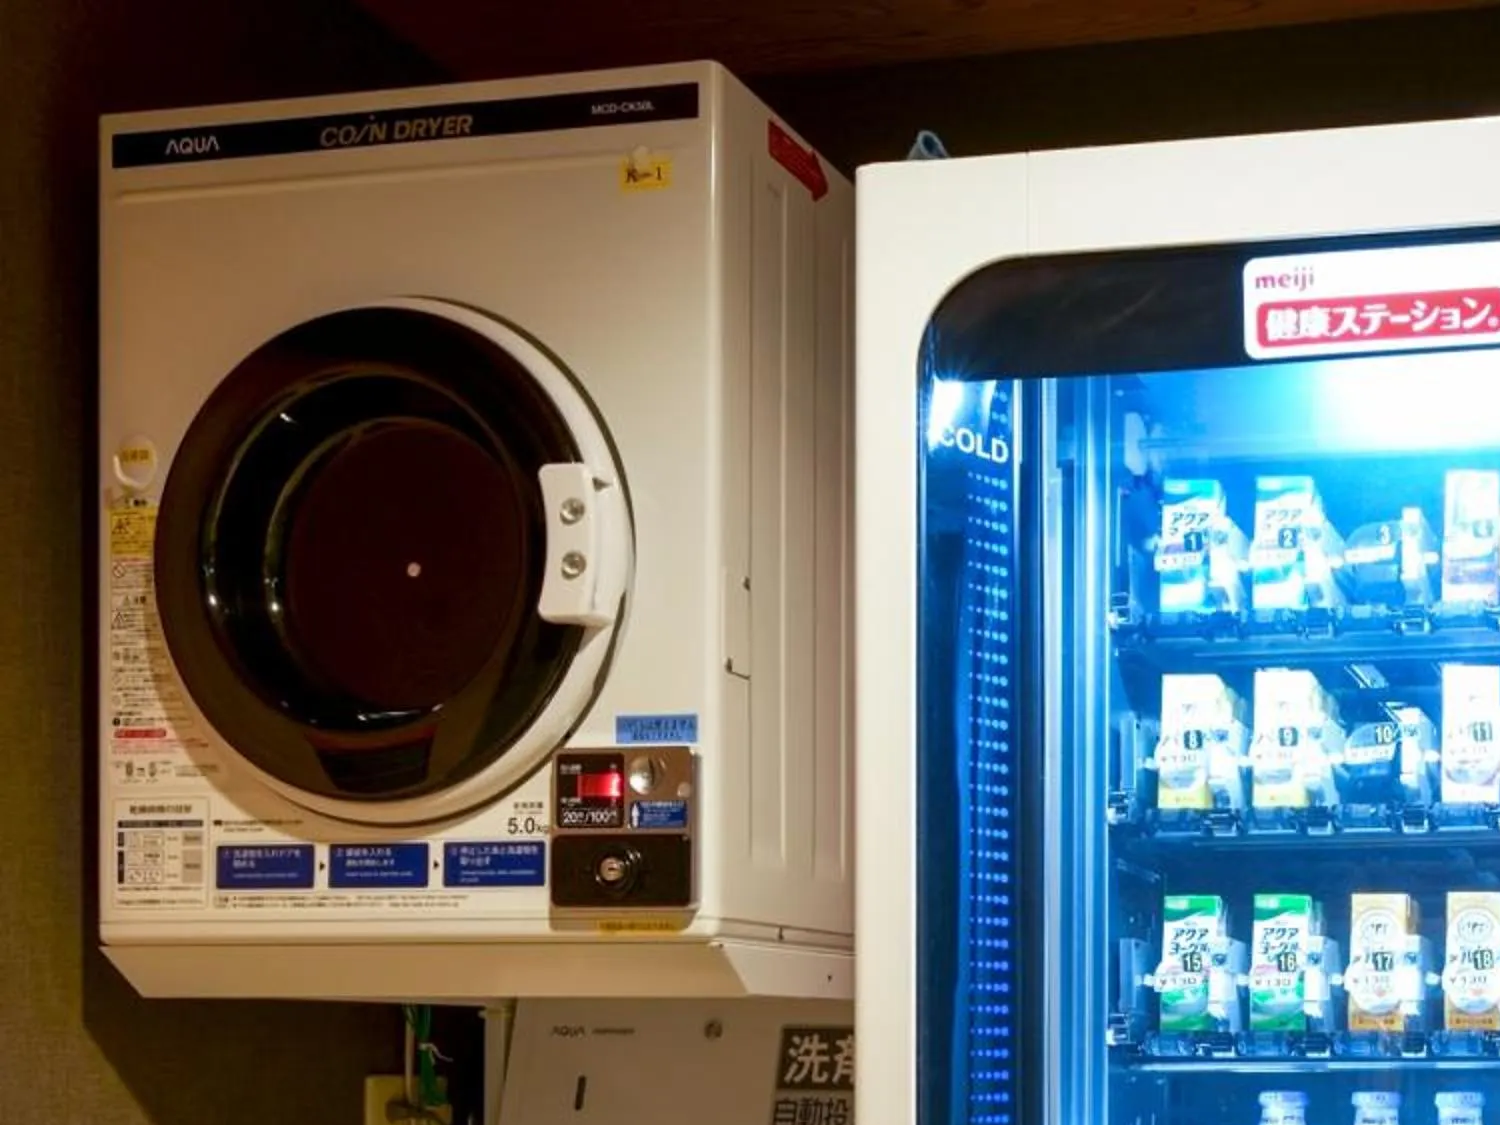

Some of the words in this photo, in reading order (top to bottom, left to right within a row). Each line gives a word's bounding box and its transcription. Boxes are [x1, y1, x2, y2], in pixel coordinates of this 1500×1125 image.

[393, 114, 474, 140] DRYER
[165, 135, 220, 155] AQUA
[1254, 266, 1315, 292] meiji
[941, 426, 1009, 464] COLD
[1375, 727, 1393, 743] 10
